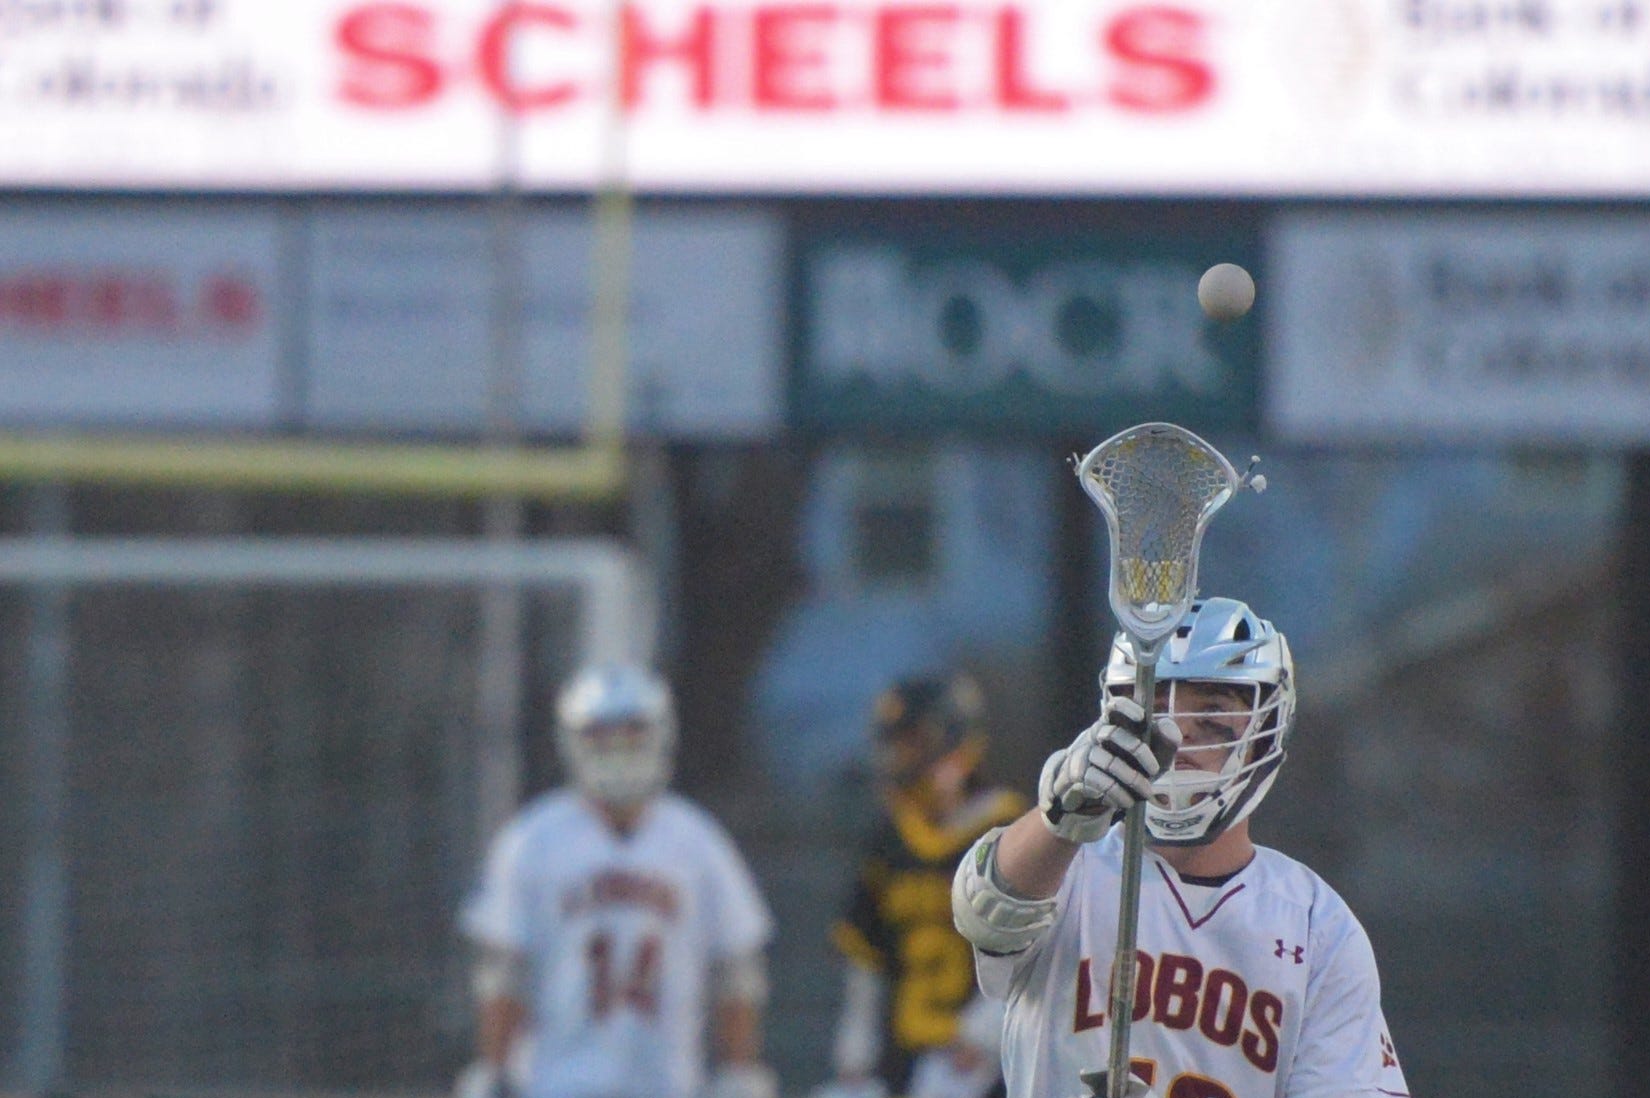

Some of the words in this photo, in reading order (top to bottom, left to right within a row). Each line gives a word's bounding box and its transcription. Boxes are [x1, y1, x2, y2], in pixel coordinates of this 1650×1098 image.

[331, 4, 1219, 111] SCHEELS
[586, 928, 662, 1022] 14
[1073, 950, 1284, 1074] LOBOS
